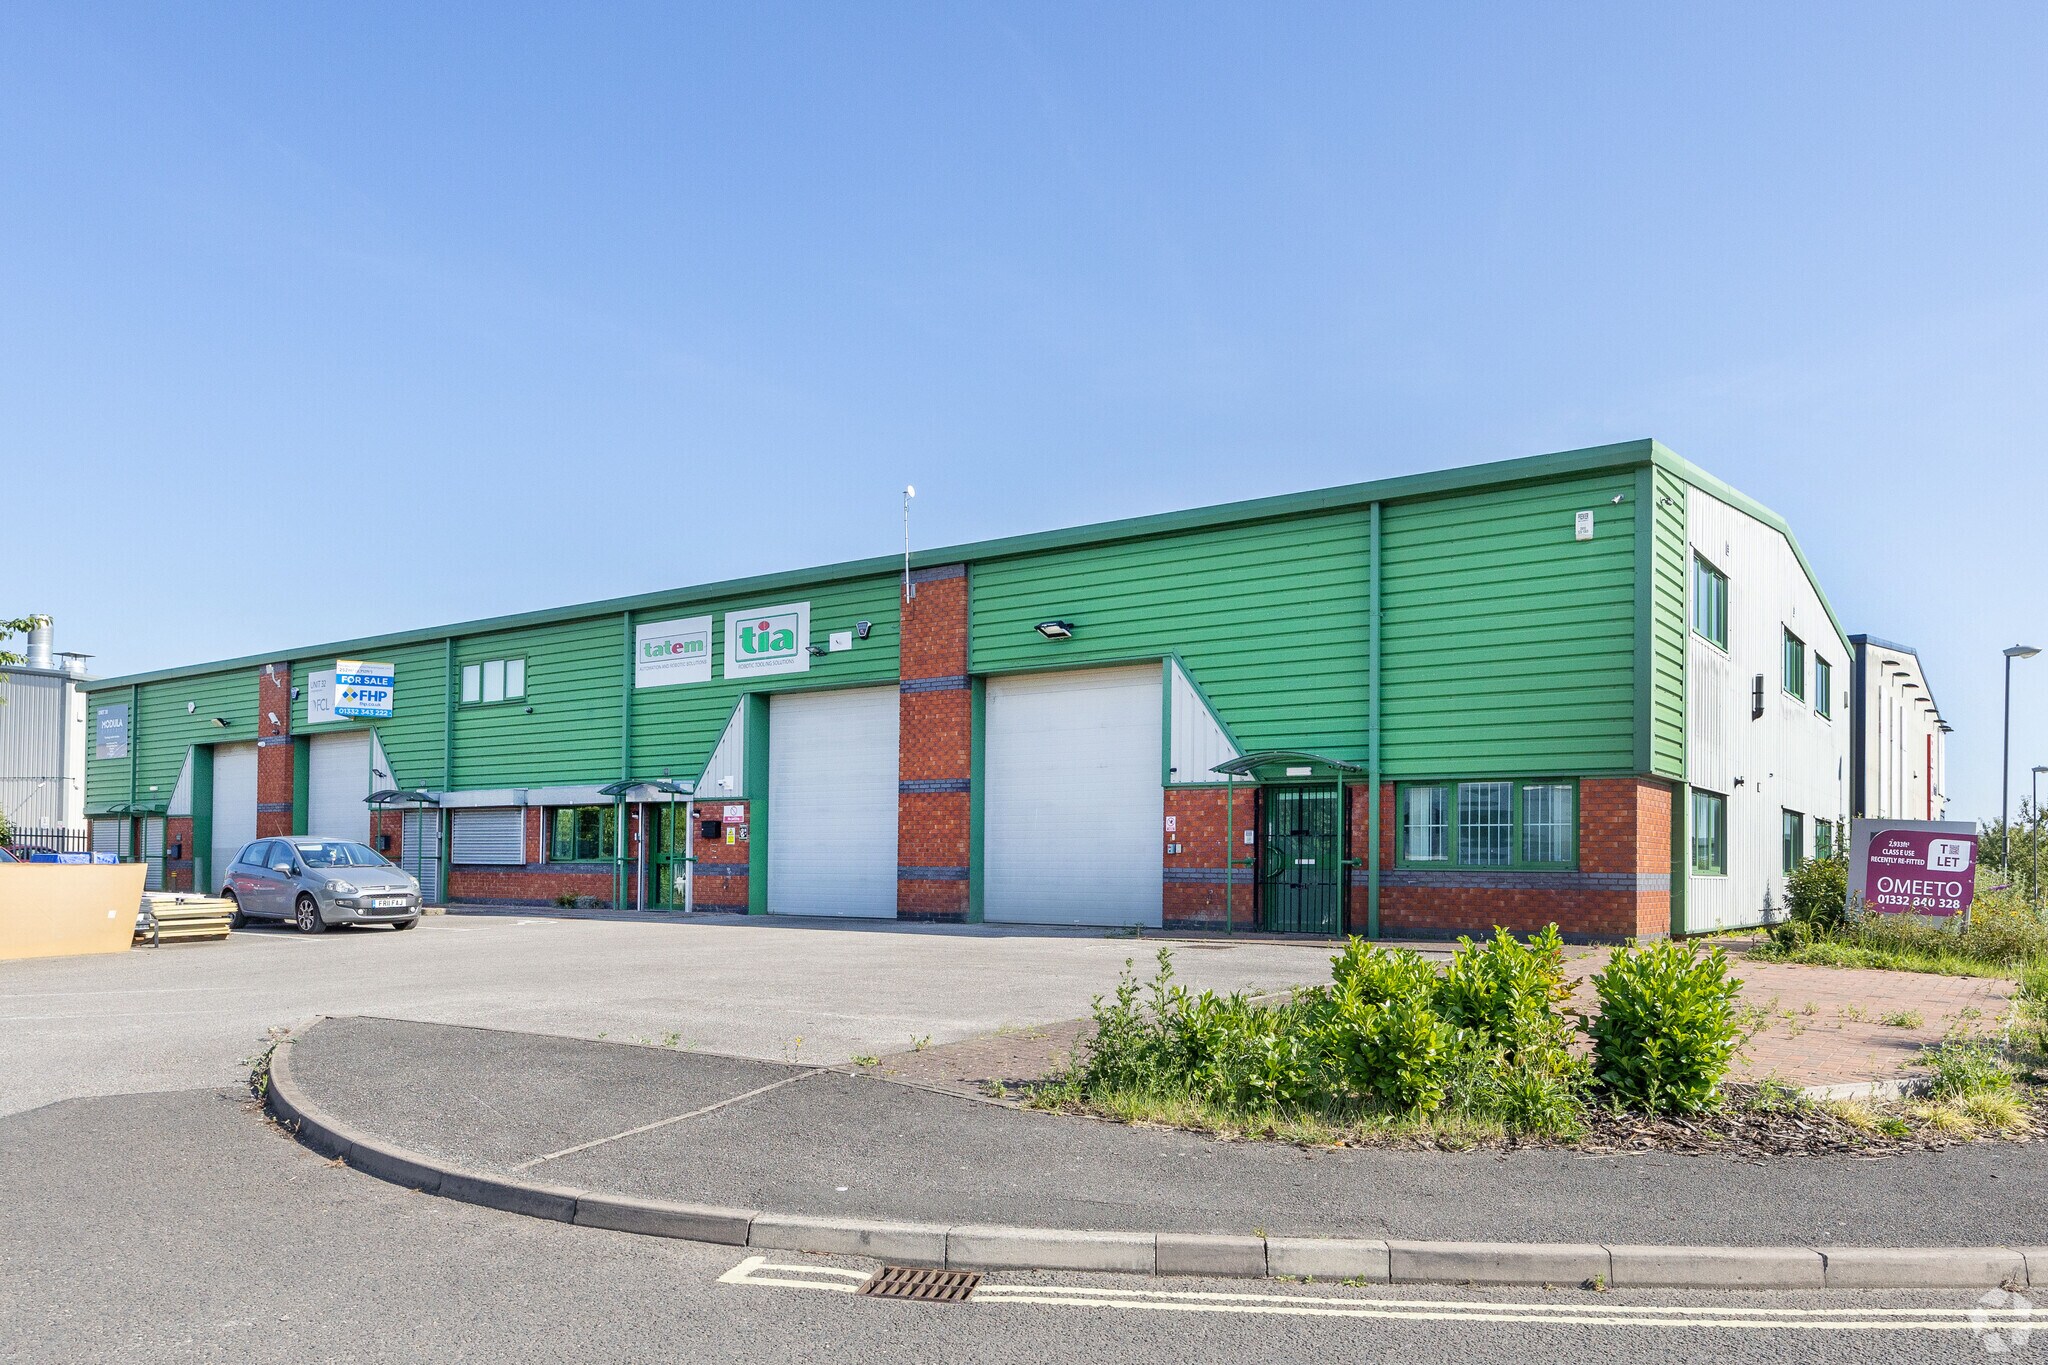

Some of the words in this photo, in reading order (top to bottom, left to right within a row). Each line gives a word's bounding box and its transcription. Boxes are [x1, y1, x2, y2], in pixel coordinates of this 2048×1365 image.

[739, 621, 794, 654] tia
[644, 640, 703, 657] tatem
[341, 676, 361, 684] FOR
[364, 677, 388, 685] SALE
[360, 690, 387, 702] FHP
[102, 719, 122, 728] MODULA
[1882, 848, 1899, 856] CLASS
[1870, 856, 1897, 864] RECENTLY
[1898, 858, 1925, 866] RE-FITTED
[1937, 856, 1960, 867] LET
[1877, 876, 1963, 898] OMEETO
[1877, 894, 1910, 906] 01332
[1938, 898, 1960, 908] 328
